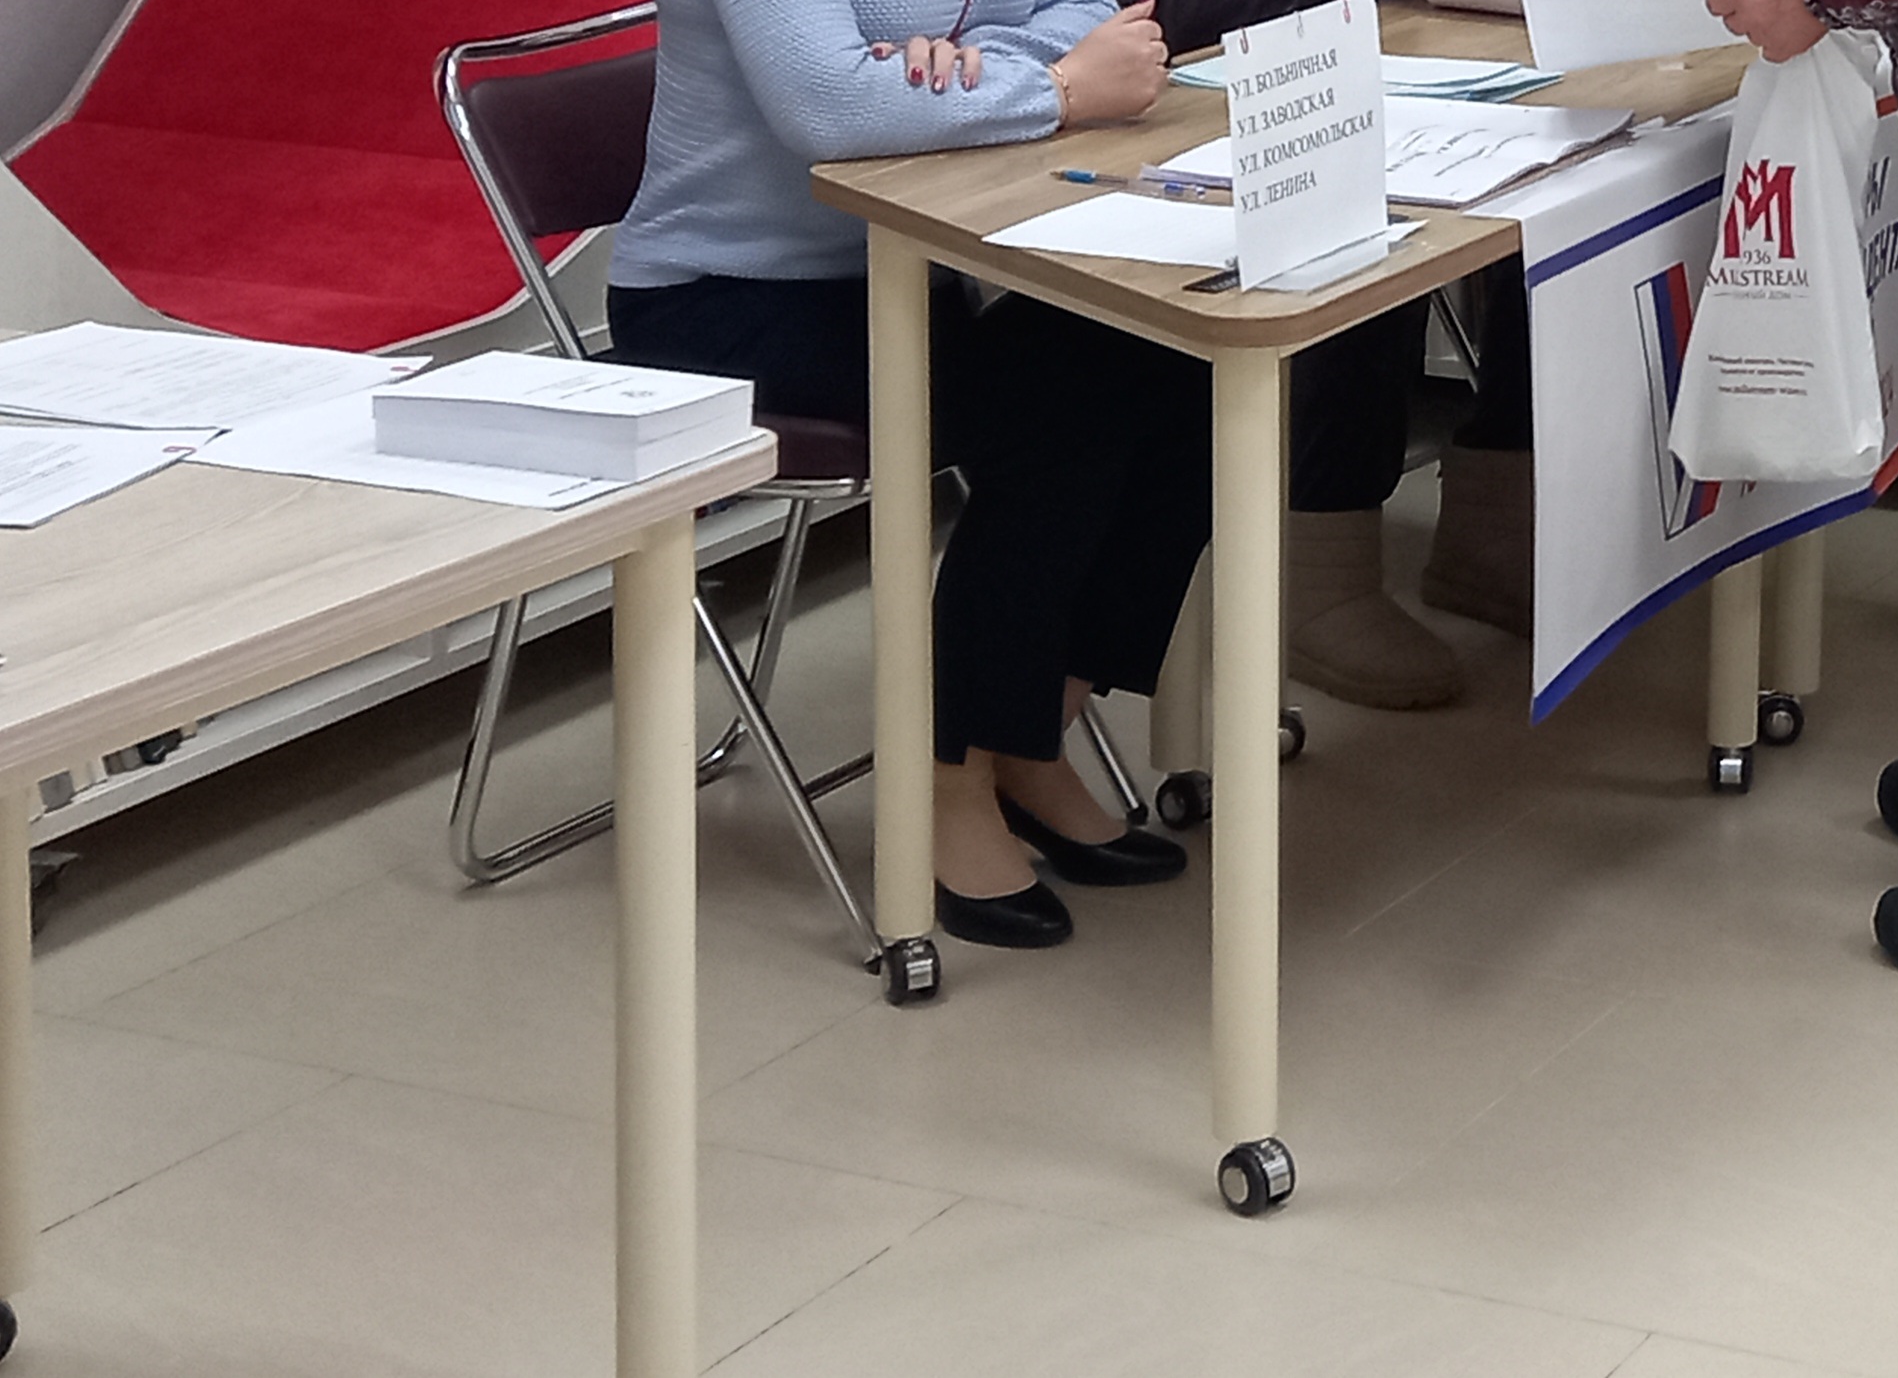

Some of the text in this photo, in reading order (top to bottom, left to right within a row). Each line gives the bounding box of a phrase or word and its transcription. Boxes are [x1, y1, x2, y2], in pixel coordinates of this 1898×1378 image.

[1255, 48, 1339, 94] БОЛЬНИЧНАЯ
[1260, 87, 1335, 131] ЗАВОДСКАЯ
[1262, 109, 1374, 168] КОМСОМОЛЬСКАЯ
[1263, 169, 1318, 206] ЛЕНИНА
[1739, 248, 1773, 265] 936
